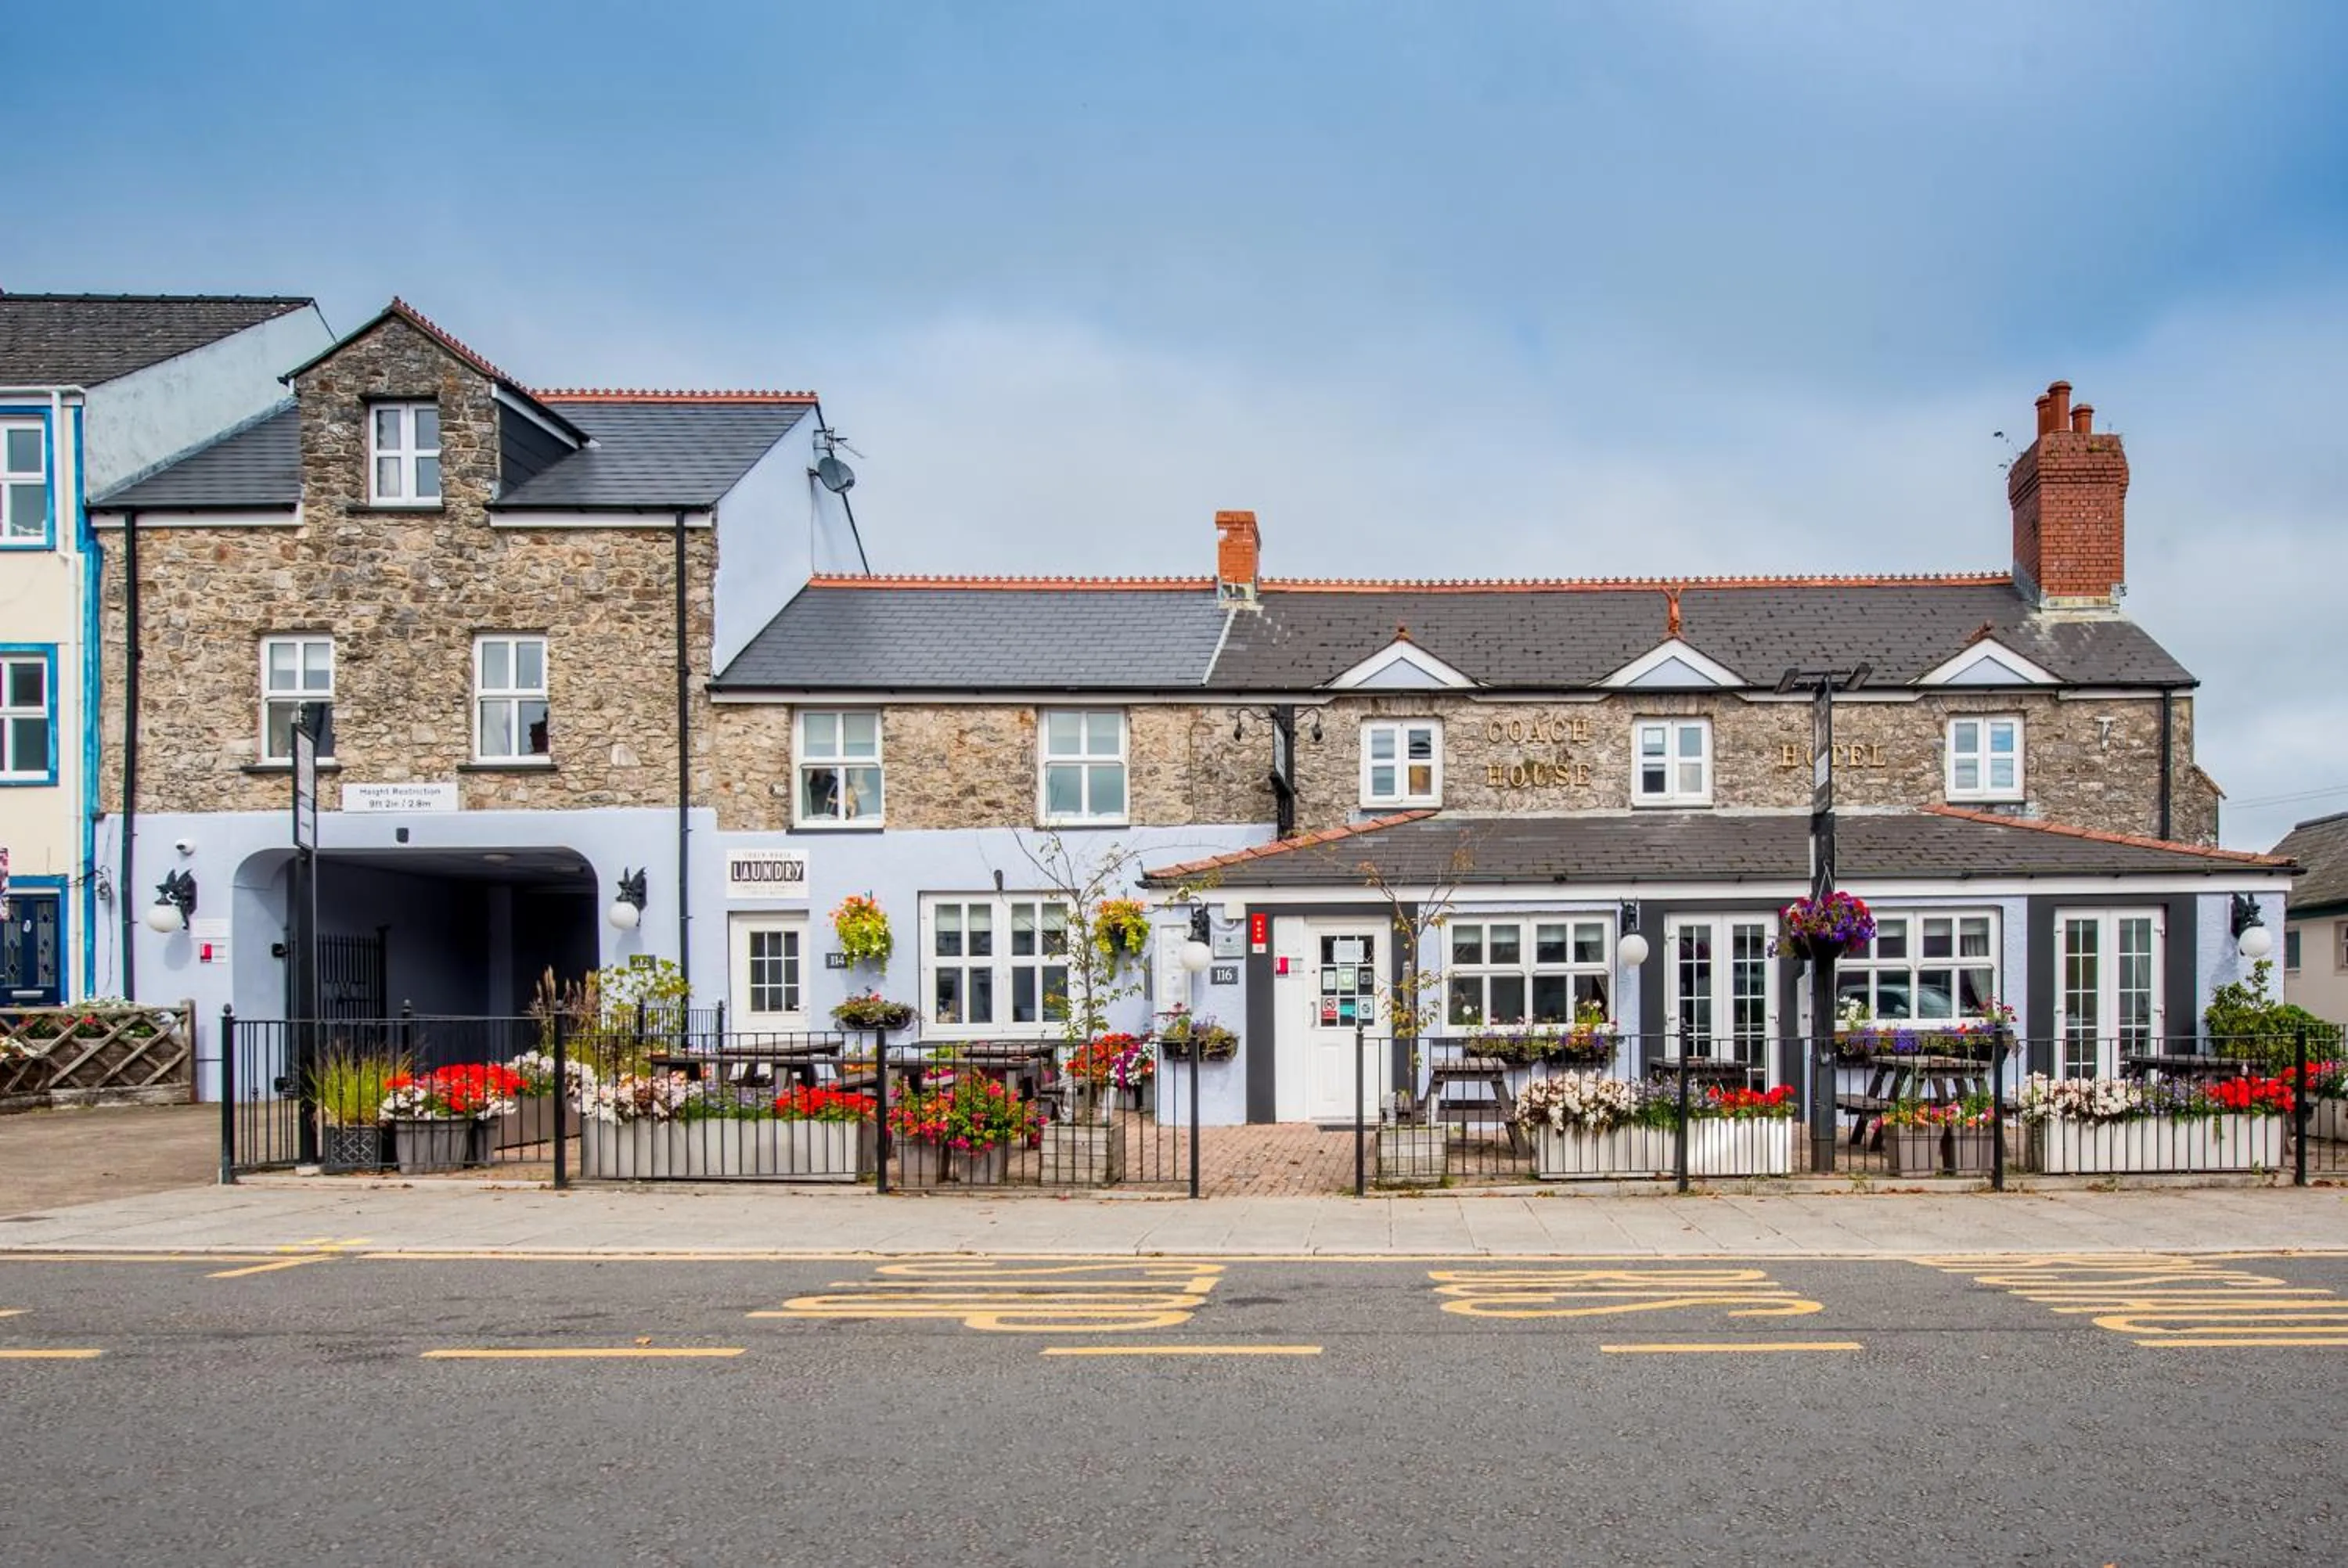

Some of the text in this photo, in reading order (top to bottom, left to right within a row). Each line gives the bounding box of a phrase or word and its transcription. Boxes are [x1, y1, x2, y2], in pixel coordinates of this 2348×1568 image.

[1488, 718, 1589, 743] COACH
[1486, 763, 1590, 787] HOUSE
[360, 788, 389, 797] Height
[733, 861, 803, 880] LAUNDRY
[1216, 969, 1233, 981] 116
[745, 1261, 1227, 1332] STOP
[1427, 1265, 1825, 1317] BUS
